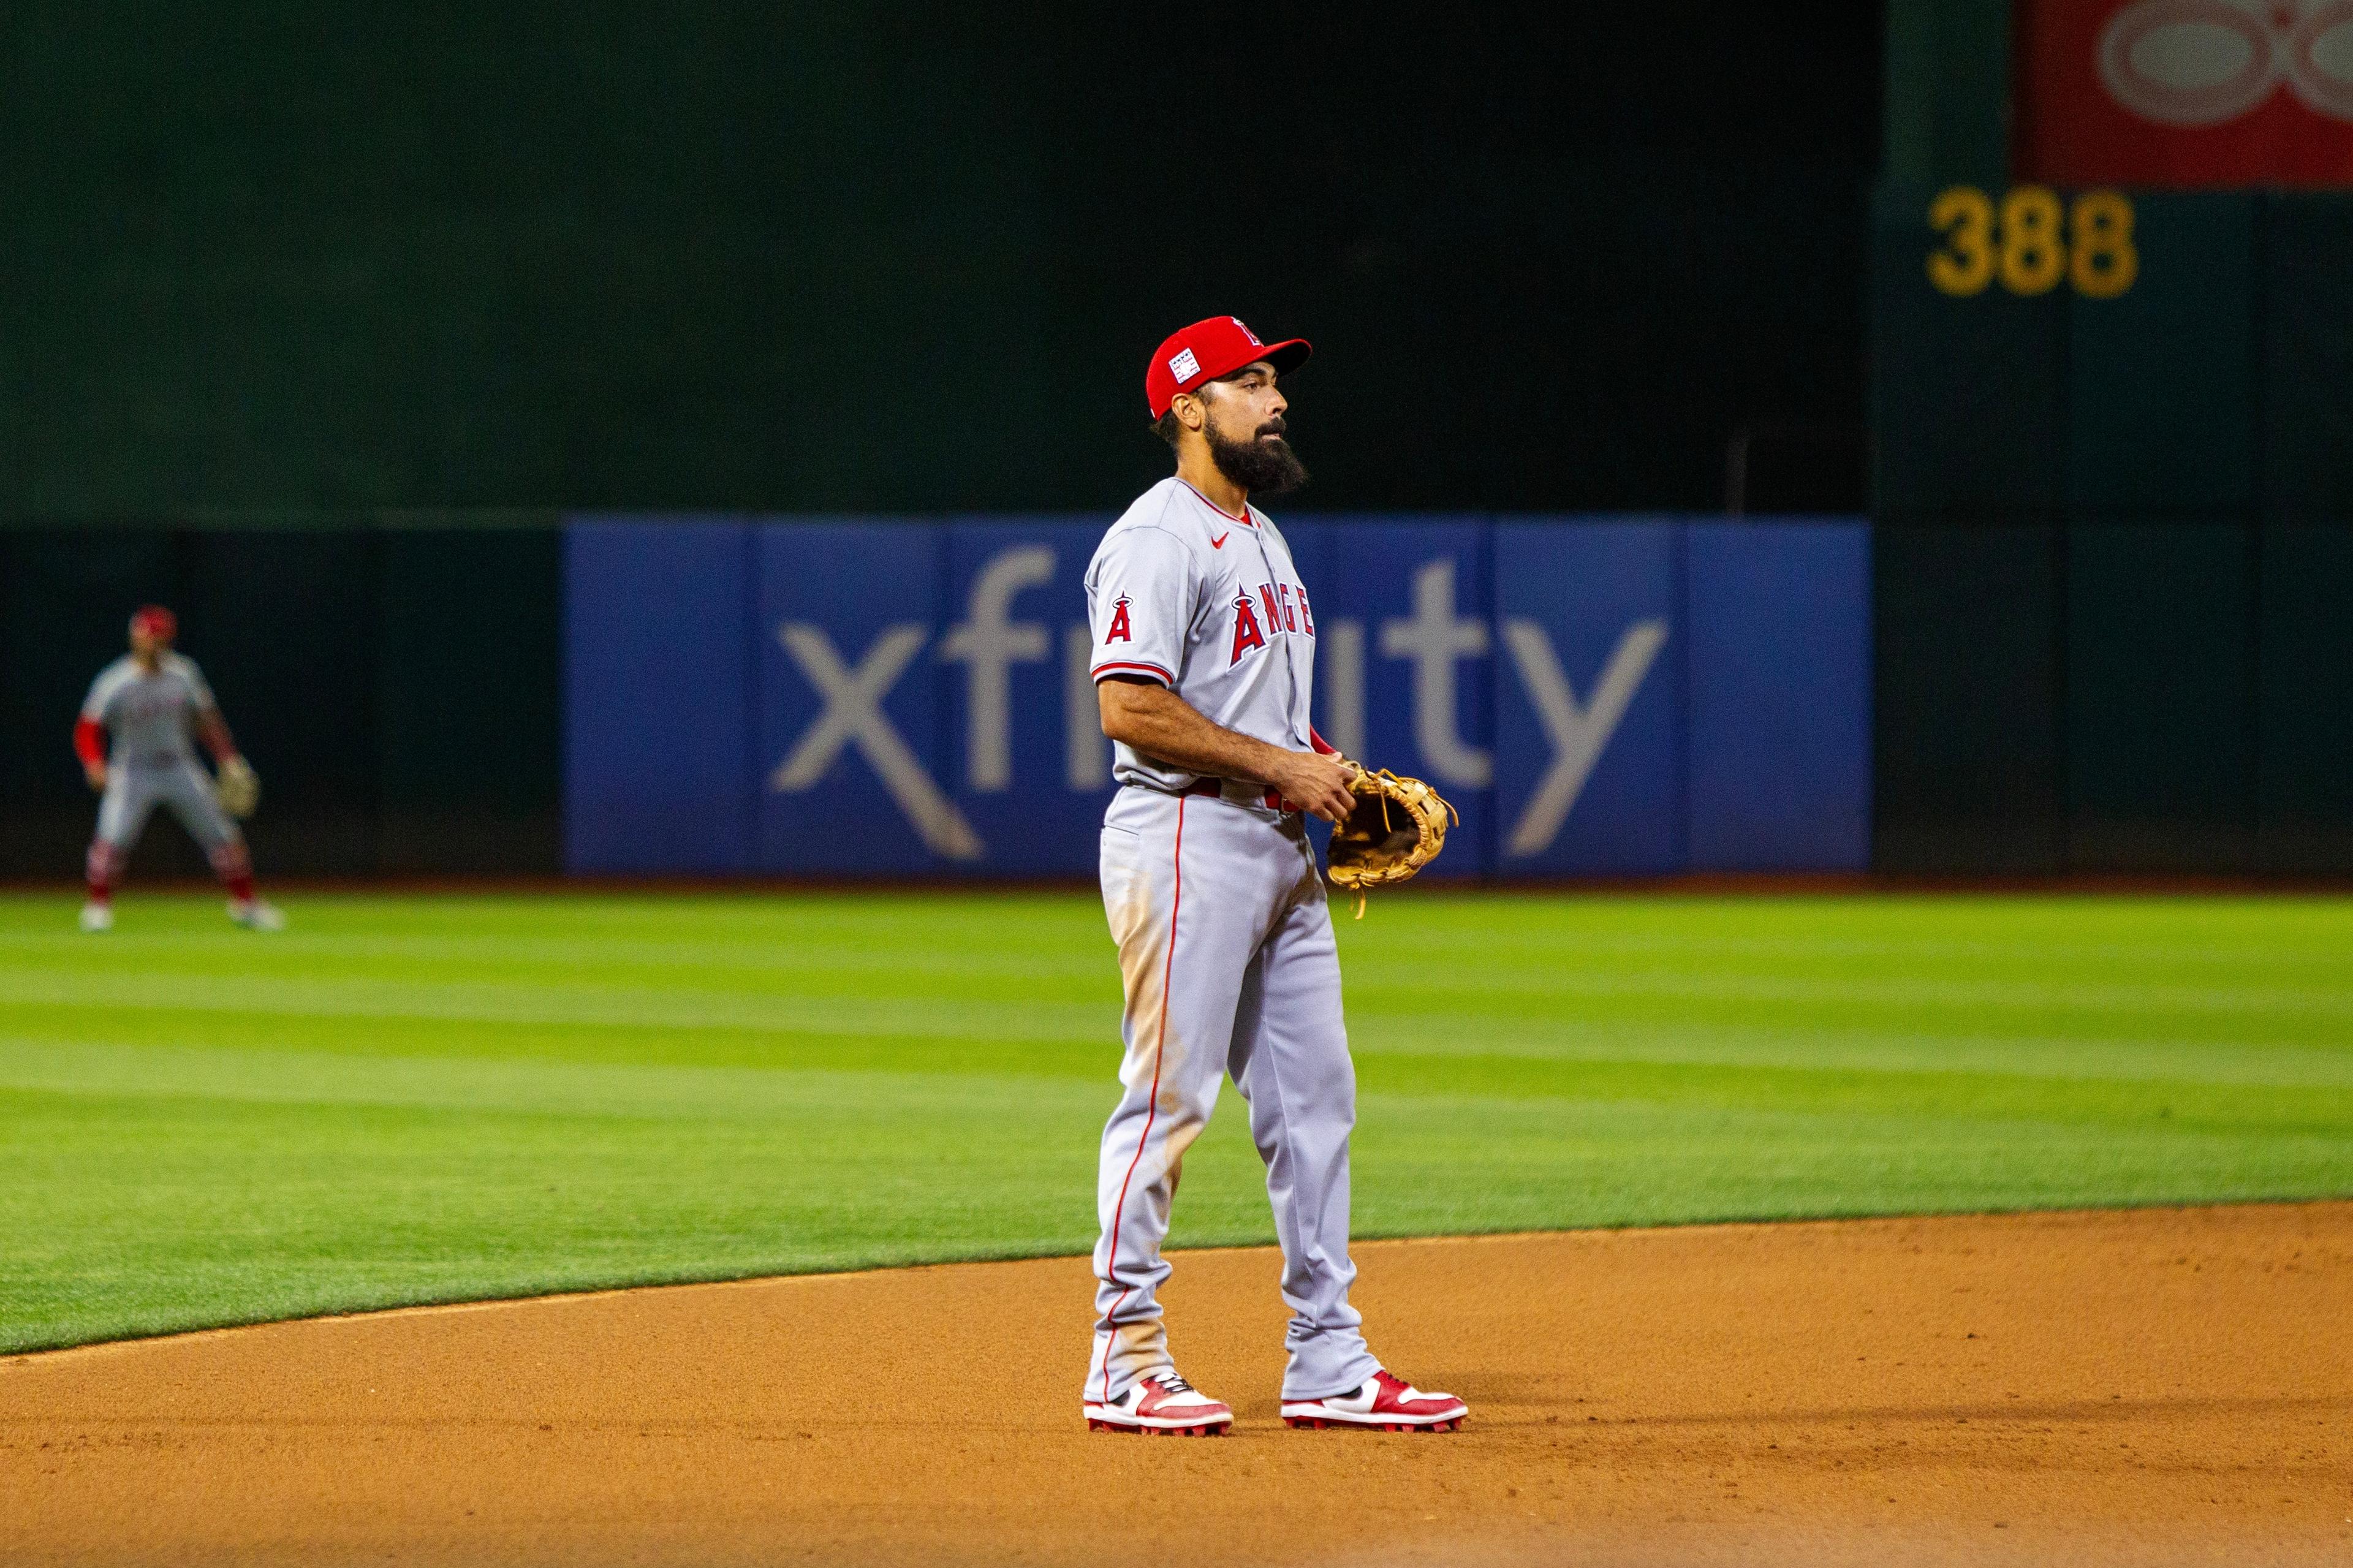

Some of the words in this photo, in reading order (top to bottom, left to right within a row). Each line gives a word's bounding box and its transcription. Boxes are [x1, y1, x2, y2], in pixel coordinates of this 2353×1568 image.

[1927, 186, 2139, 297] 388
[1104, 589, 1134, 645] A
[771, 544, 1669, 859] xfiity
